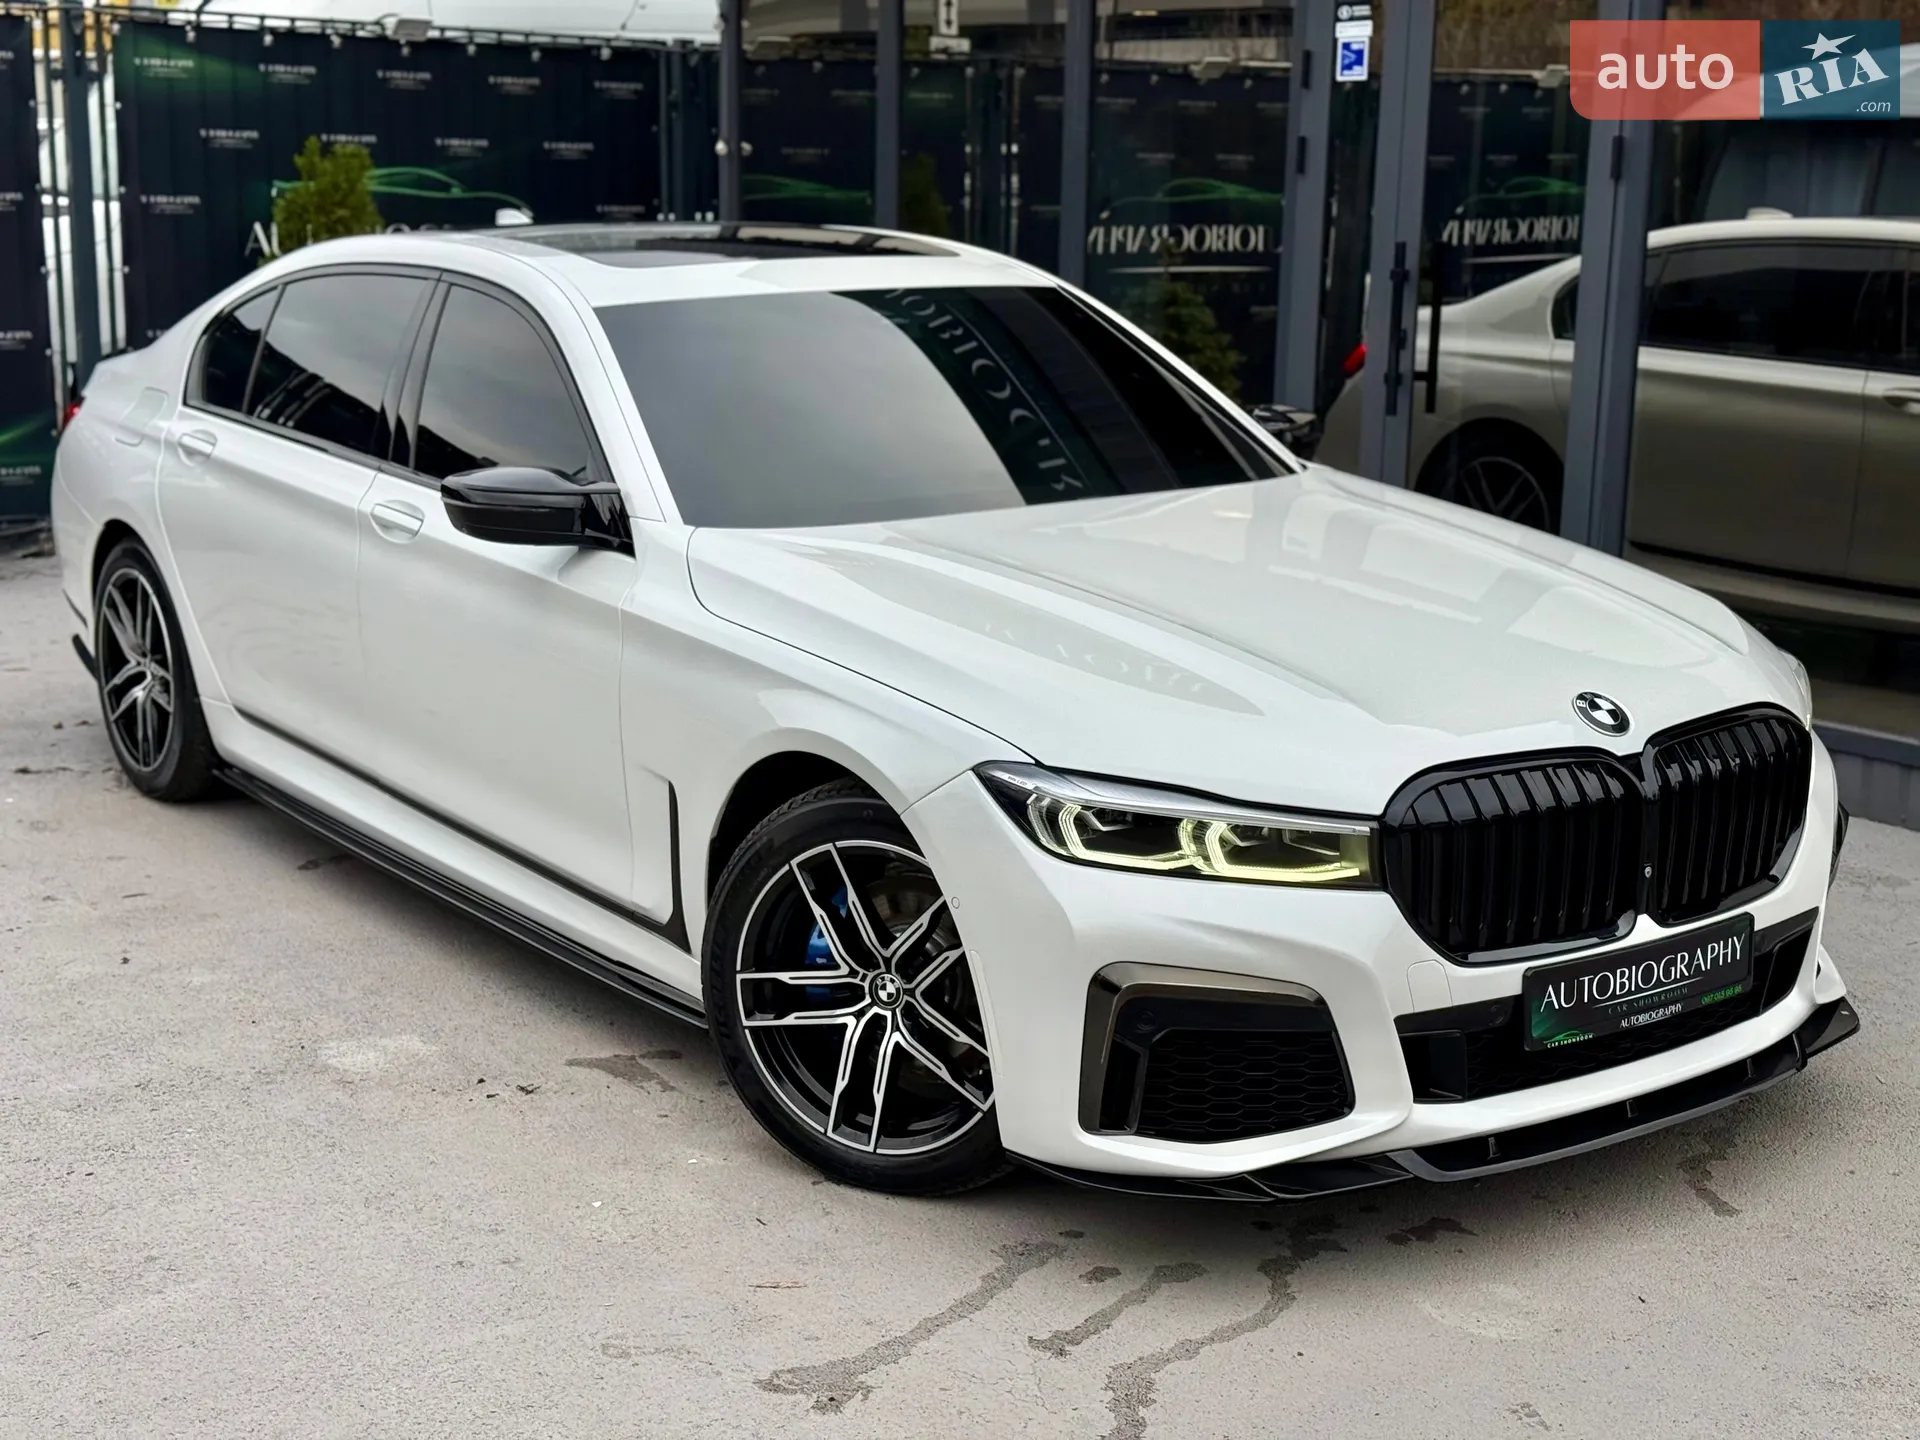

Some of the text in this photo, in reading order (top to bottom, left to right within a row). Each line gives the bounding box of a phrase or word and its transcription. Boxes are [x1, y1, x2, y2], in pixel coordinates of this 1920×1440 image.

[1540, 933, 1745, 1013] AUTOBIOGRAPHY
[1608, 986, 1689, 1015] CAR SHOWROOM
[1619, 1002, 1683, 1029] AUTOBIOGRAPHY
[1547, 1033, 1593, 1049] CAR SHOWROOM
